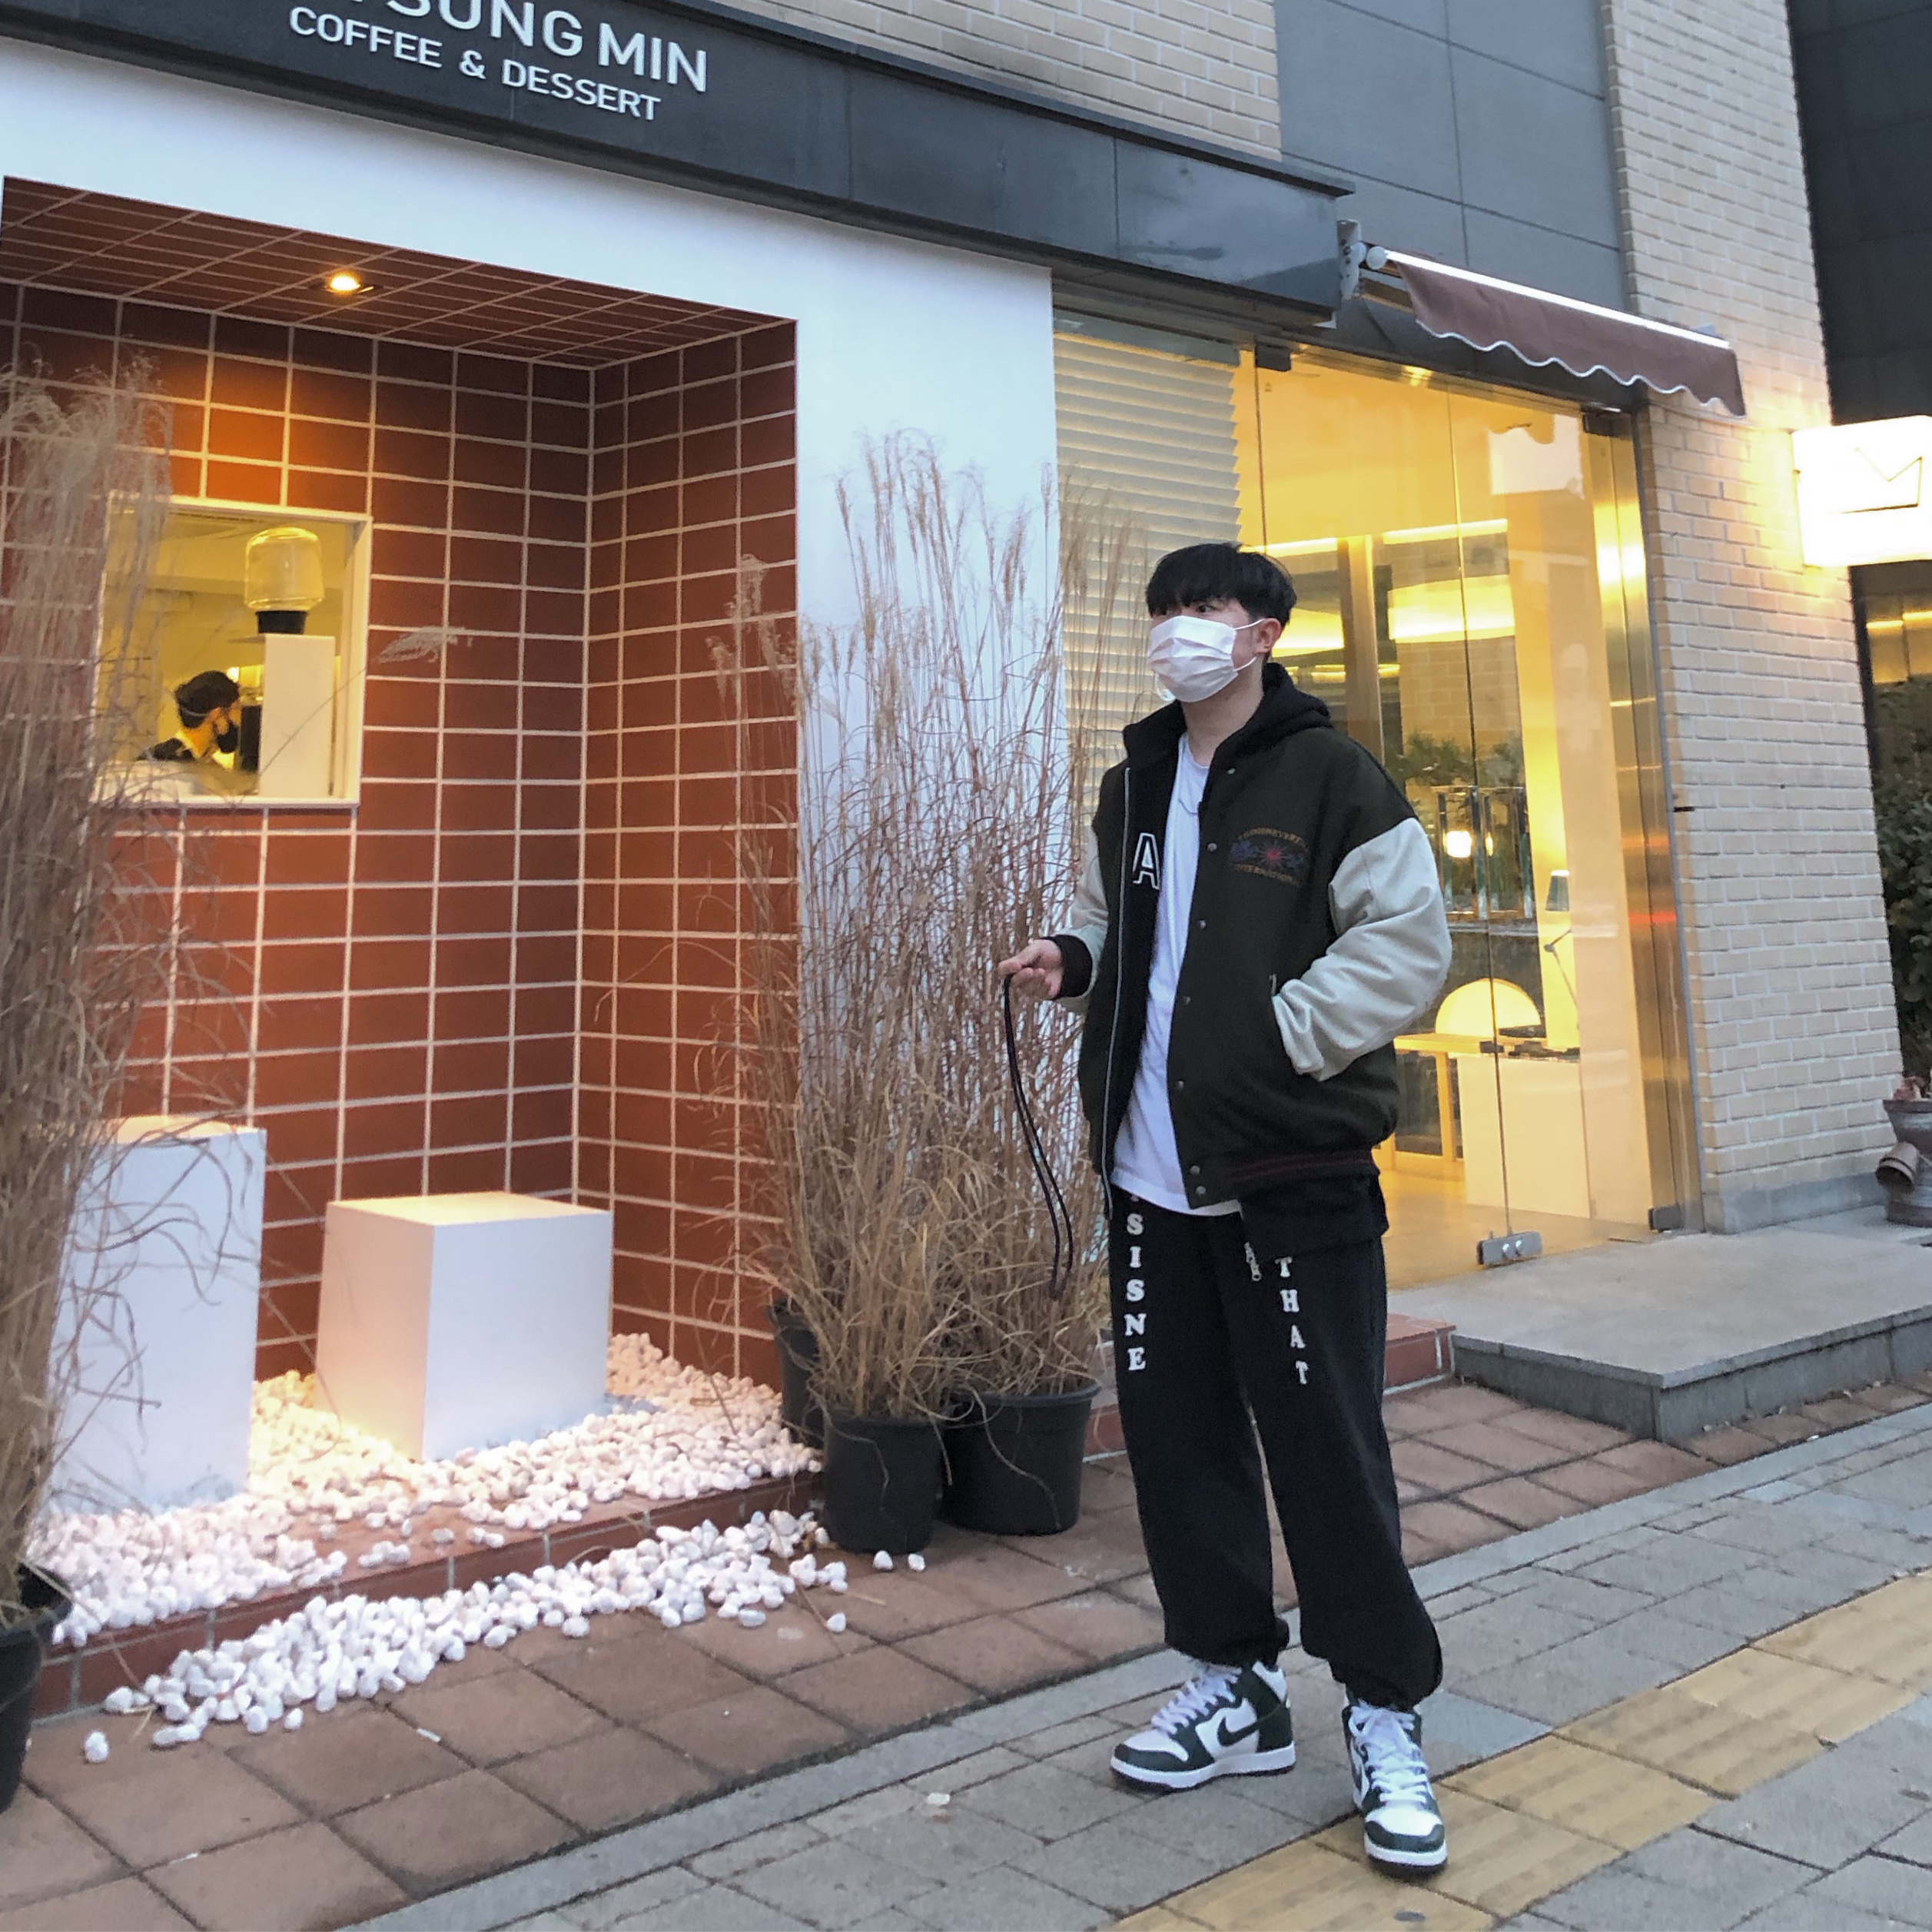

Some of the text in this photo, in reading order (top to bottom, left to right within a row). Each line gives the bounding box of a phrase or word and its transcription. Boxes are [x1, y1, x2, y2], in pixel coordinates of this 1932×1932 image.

[289, 6, 662, 121] COFFEE & DESSERT
[598, 22, 708, 92] MIN
[1132, 832, 1160, 890] A
[1275, 1256, 1309, 1384] THAT
